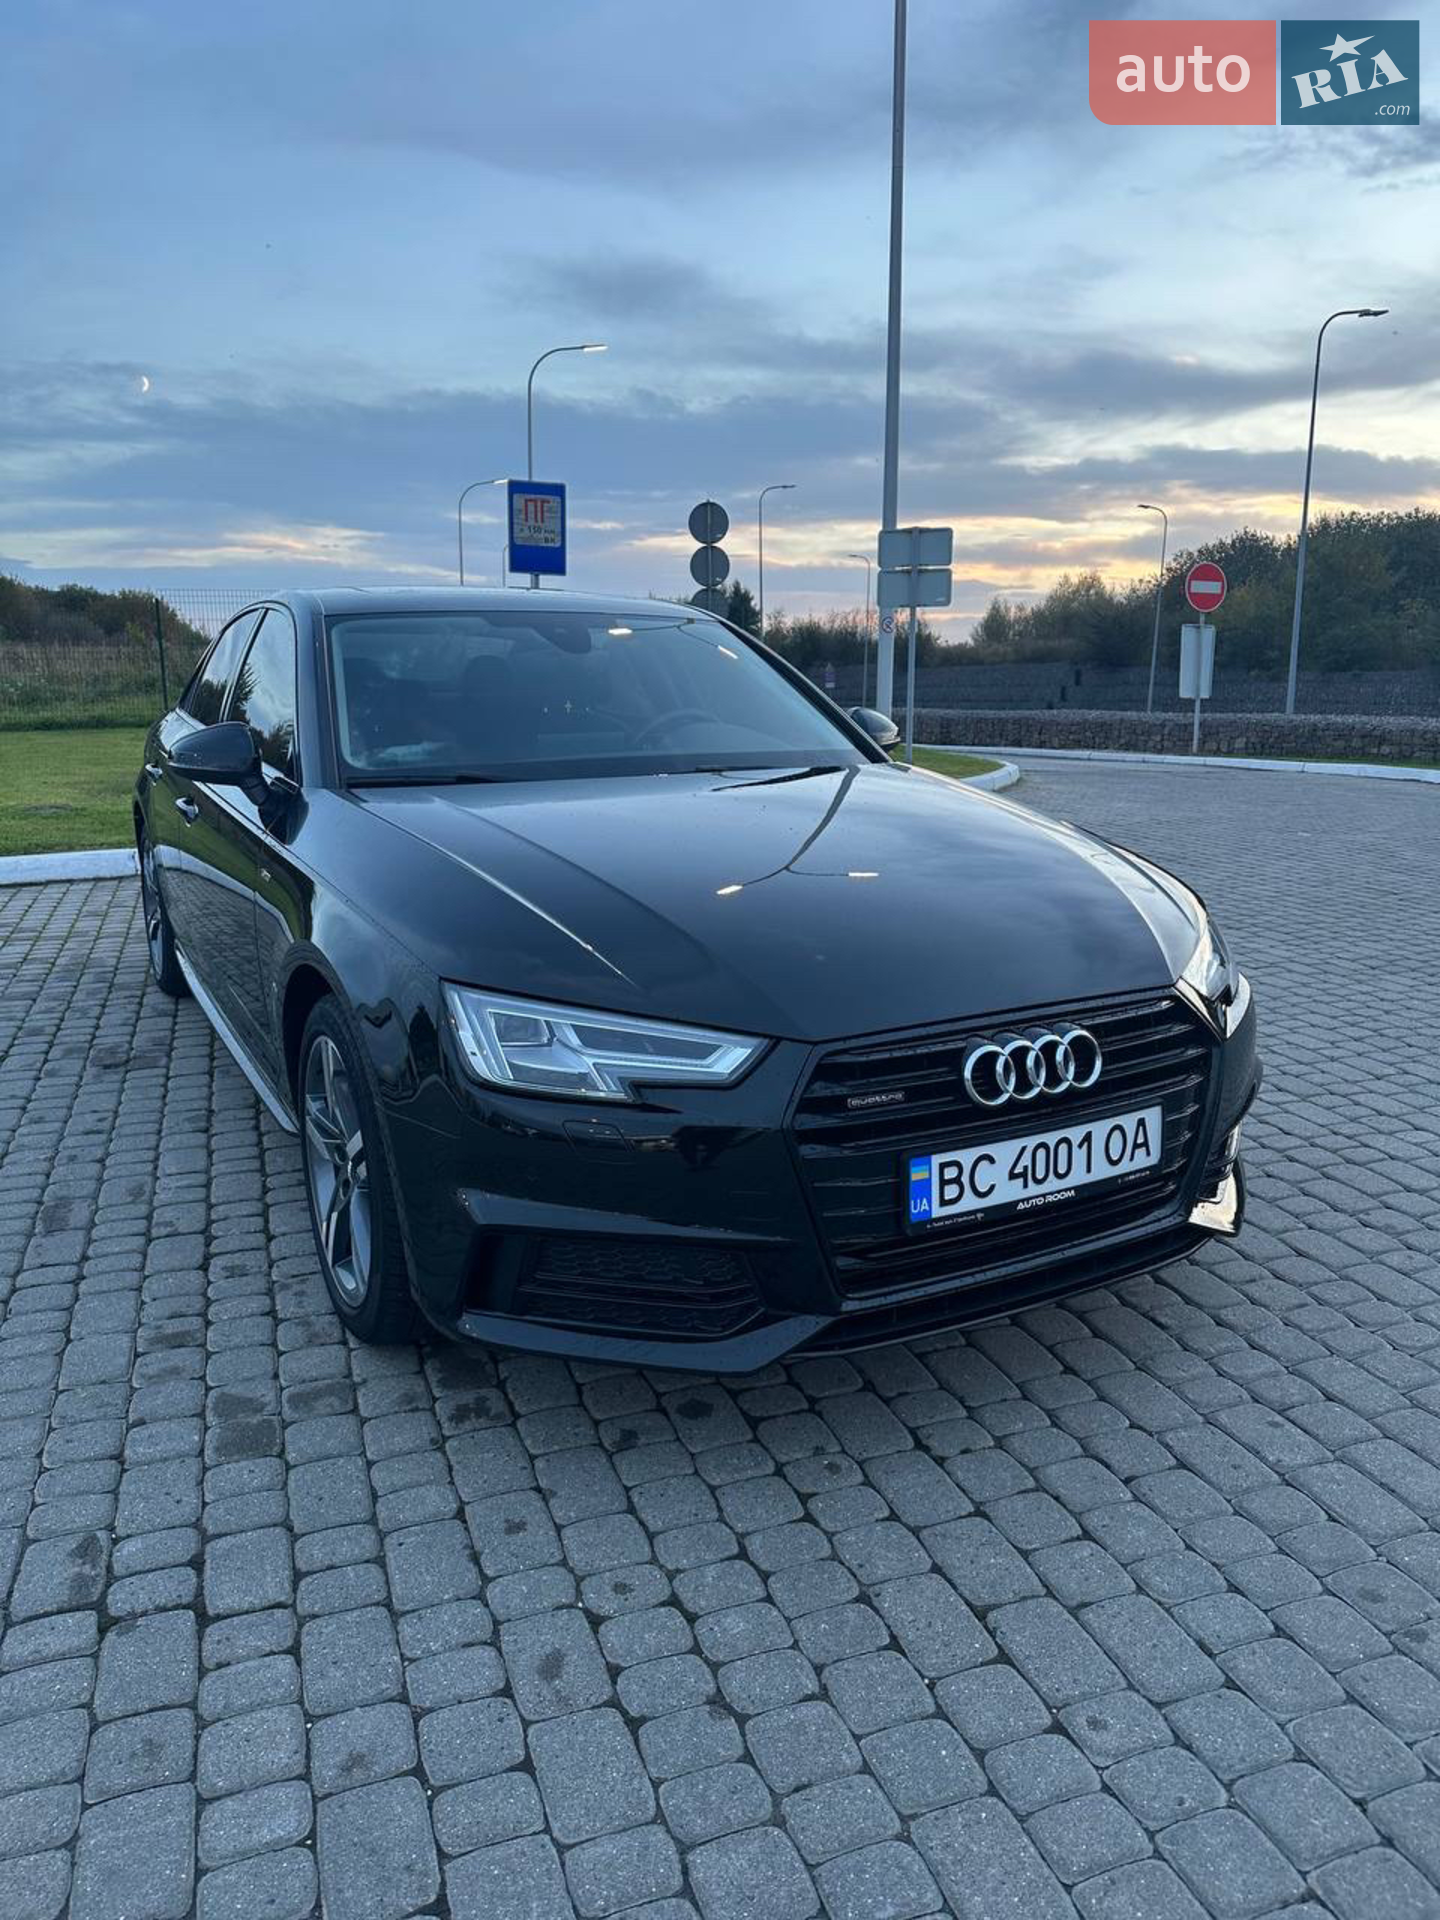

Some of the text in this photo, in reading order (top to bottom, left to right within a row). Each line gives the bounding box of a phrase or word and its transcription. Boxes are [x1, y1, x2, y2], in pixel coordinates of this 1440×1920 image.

[938, 1117, 1152, 1208] BC 4001 OA
[911, 1197, 930, 1214] UA
[1016, 1189, 1076, 1210] AUTO ROOM
